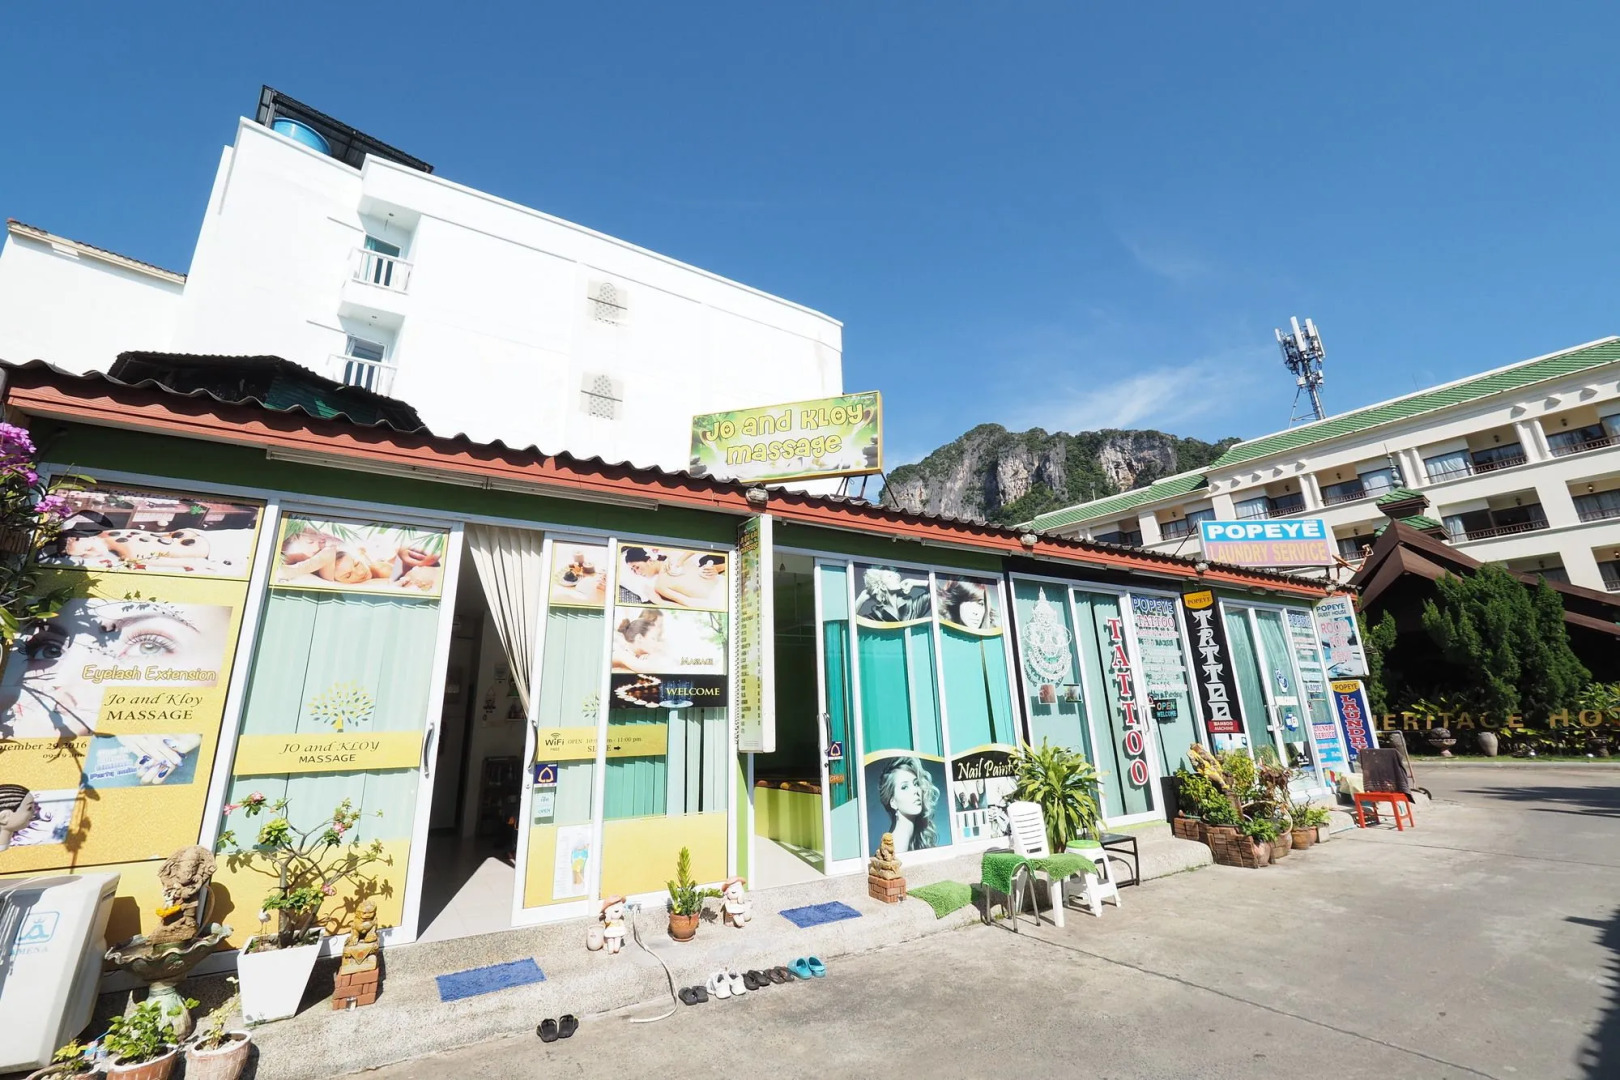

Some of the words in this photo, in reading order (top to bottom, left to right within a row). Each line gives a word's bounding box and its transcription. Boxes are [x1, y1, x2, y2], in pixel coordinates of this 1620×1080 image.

[741, 408, 792, 437] and
[726, 434, 843, 465] massage
[1207, 522, 1321, 539] POPEYE
[1209, 543, 1268, 562] LAUNDRY
[1272, 542, 1328, 561] SERVICE
[1187, 595, 1211, 605] POPEYE
[1316, 603, 1346, 612] POPEYE
[1136, 614, 1176, 628] TATTOO
[1320, 621, 1351, 634] ROOM
[1330, 636, 1346, 647] FOR
[82, 664, 140, 683] Eyelash
[145, 665, 216, 682] Extension
[665, 687, 720, 696] WELCOME
[1335, 683, 1358, 691] POPEYE
[104, 692, 125, 707] Jo
[130, 692, 163, 705] and
[165, 692, 203, 708] Kloy
[1106, 617, 1149, 786] TATTOO
[1156, 702, 1176, 710] OPEN
[106, 709, 193, 721] MASSAGE
[1156, 710, 1177, 718] WELCOME
[1340, 694, 1369, 754] LAUNDRY
[304, 741, 336, 752] and
[545, 738, 565, 747] WiFi
[587, 744, 612, 753] SLE
[298, 754, 357, 763] MASSAGE
[957, 757, 984, 779] Nail
[984, 759, 1014, 777] Paint
